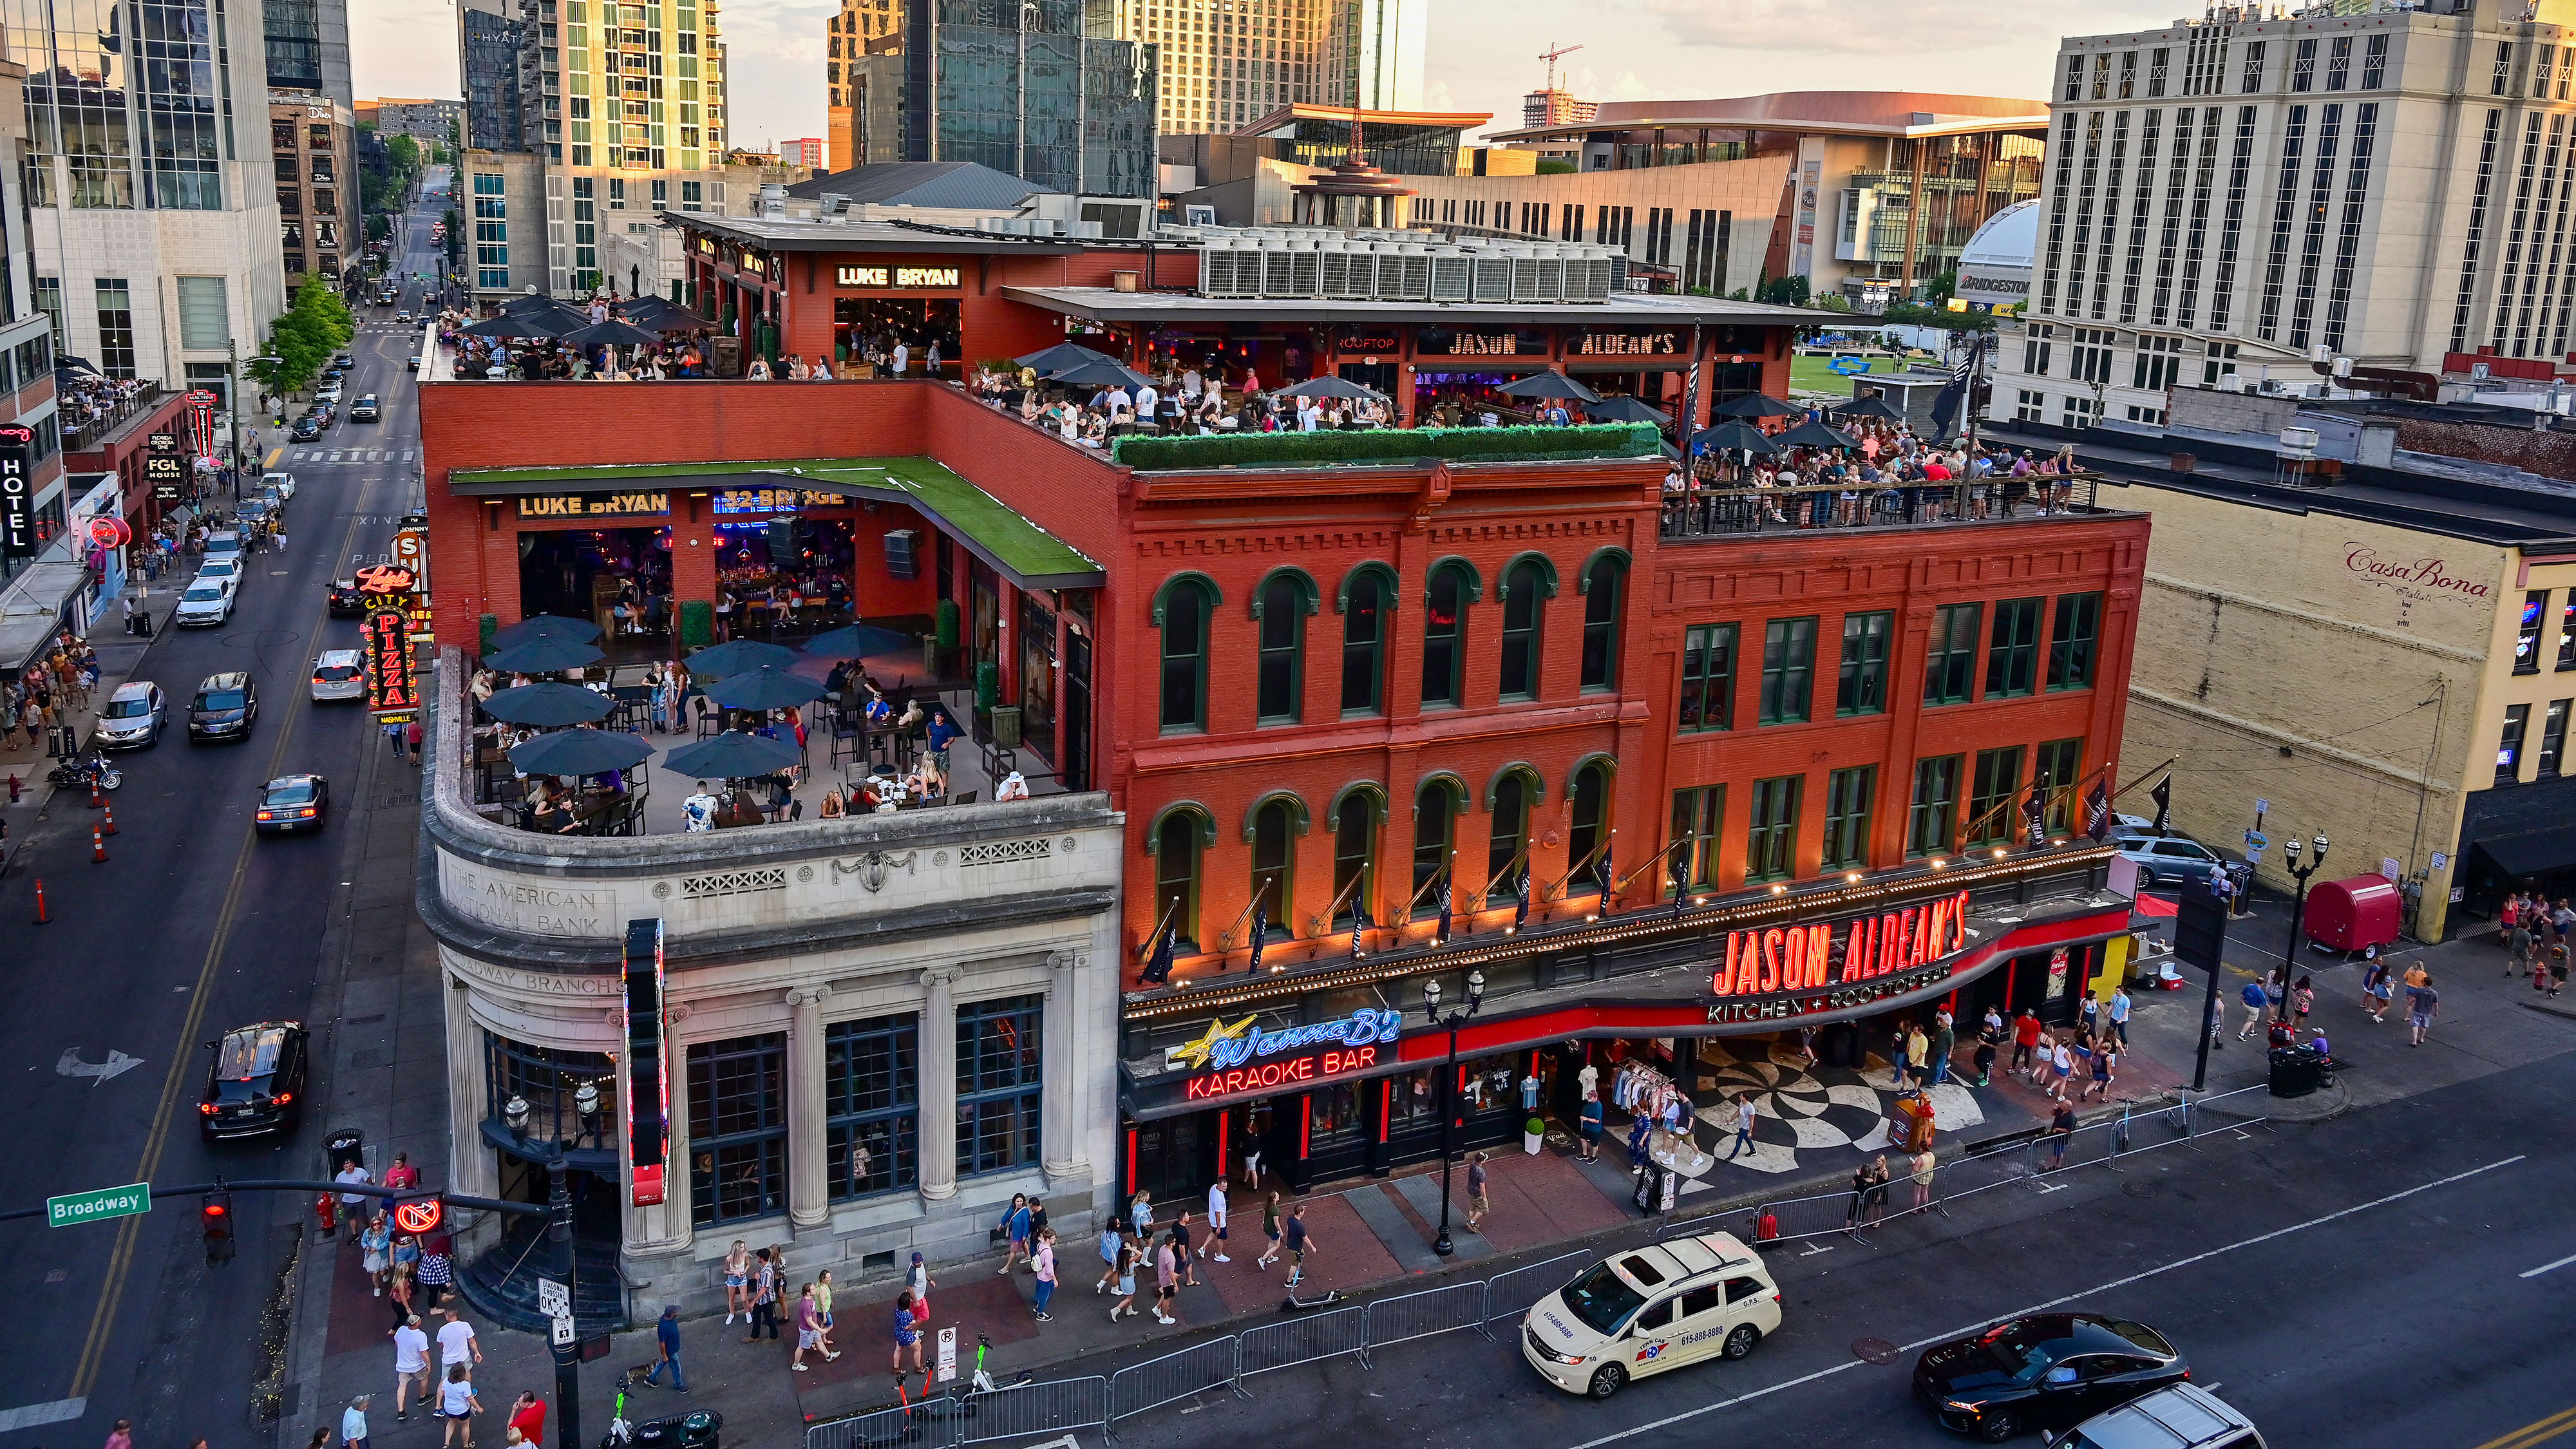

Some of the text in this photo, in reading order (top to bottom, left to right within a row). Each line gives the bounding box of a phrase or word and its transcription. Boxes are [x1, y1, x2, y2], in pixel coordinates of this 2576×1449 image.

[482, 33, 522, 44] HYAT
[307, 106, 332, 118] Diner
[838, 268, 958, 286] LUKE BRYAN
[1581, 334, 1675, 355] ALDEAN'S
[0, 428, 30, 442] oxy
[200, 410, 208, 457] DISTILLERY
[149, 459, 180, 471] FGL
[3, 459, 26, 546] HOTEL
[520, 497, 582, 516] LUKE
[724, 490, 753, 508] 32
[356, 565, 413, 592] Luigi's
[2343, 541, 2489, 598] Casa Bona
[365, 595, 408, 609] CITY
[2396, 587, 2432, 602] Italian
[2401, 600, 2412, 609] bar
[2397, 619, 2410, 628] grill
[377, 614, 406, 706] PIZZA
[381, 714, 411, 724] NASHVILLE
[451, 864, 595, 909] THE AMERICAN
[452, 889, 598, 934] NATIONAL BANK
[1713, 890, 1970, 996] JASON ALDEAN'S
[526, 974, 611, 994] BRANCH
[1707, 999, 1806, 1023] KITCHEN
[1830, 976, 1919, 1009] ROOFTOP
[1922, 965, 1952, 988] BAR
[1209, 1022, 1350, 1070] Wanna
[1189, 1047, 1376, 1100] KARAOKE BAR
[1644, 1169, 1654, 1184] Y'all
[54, 1195, 139, 1218] Broadway
[543, 1280, 565, 1294] DIAGONAL
[544, 1288, 566, 1300] CROSSING
[542, 1296, 553, 1311] OK
[1743, 1298, 1759, 1307] G.P.S.
[1543, 1311, 1575, 1340] 615-888-8888
[1639, 1339, 1654, 1350] TENN
[1681, 1325, 1724, 1346] 615-888-8888
